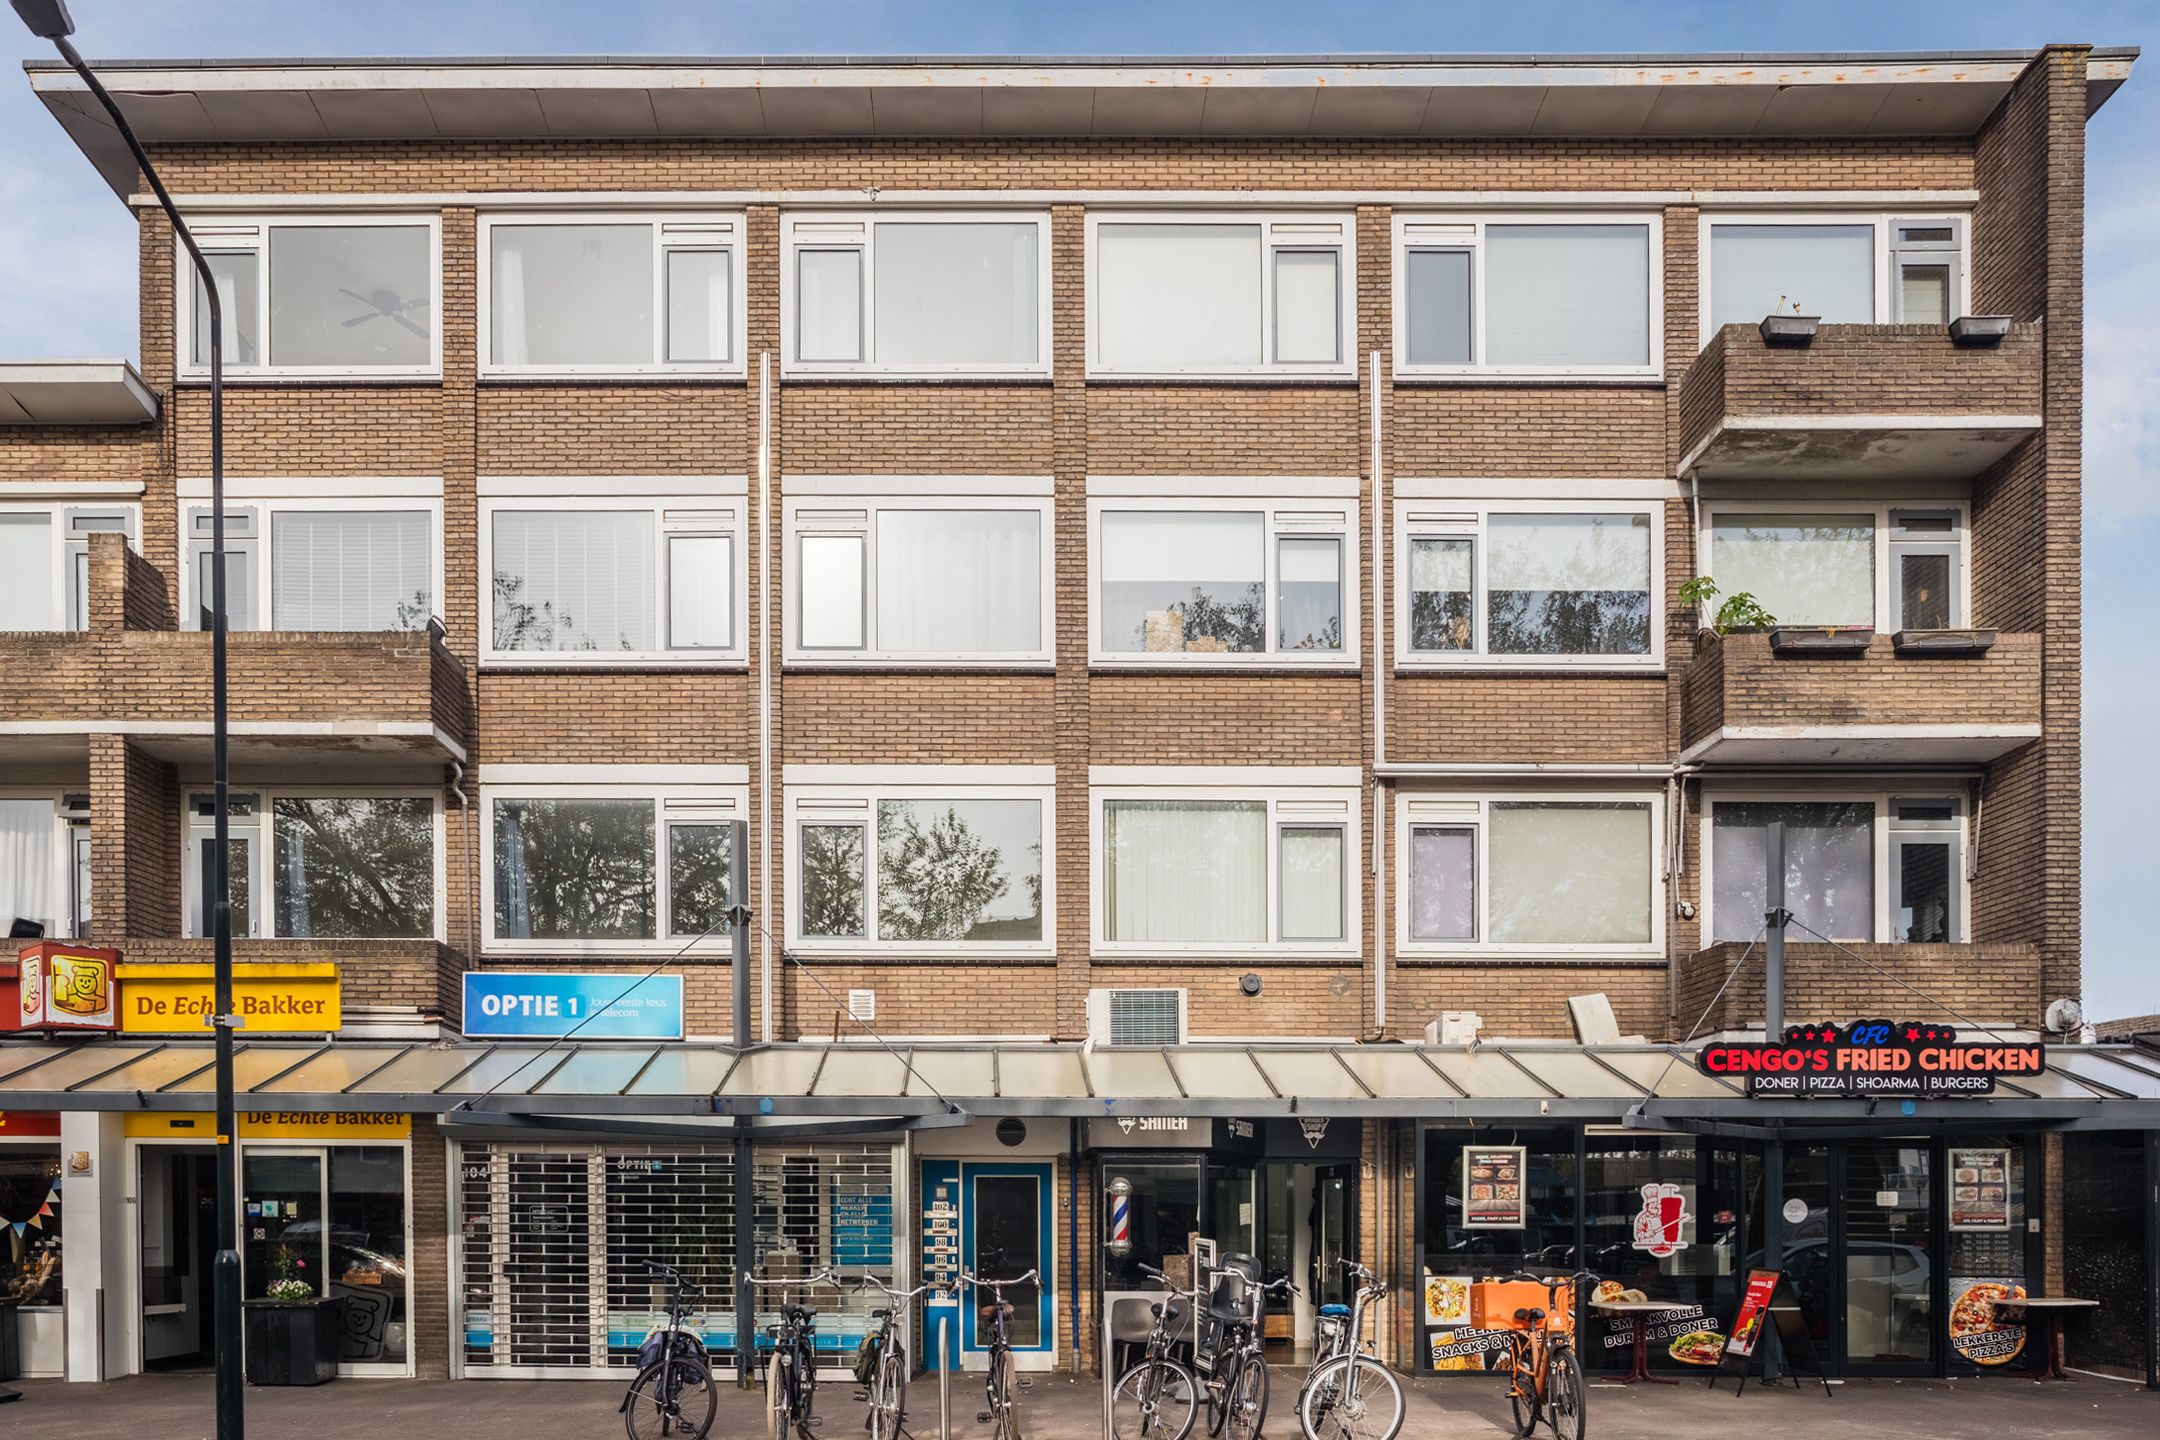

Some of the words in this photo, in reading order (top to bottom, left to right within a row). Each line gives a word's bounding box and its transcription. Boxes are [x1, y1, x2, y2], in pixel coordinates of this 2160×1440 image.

[136, 996, 166, 1015] De
[173, 996, 236, 1015] Ech
[241, 995, 326, 1014] Bakker
[481, 994, 559, 1016] OPTIE
[567, 998, 578, 1016] 1
[1850, 1025, 1889, 1045] CFC
[1706, 1049, 1829, 1072] CENGO'S
[1836, 1048, 1911, 1071] FRIED
[1918, 1048, 2039, 1071] CHICKEN
[1755, 1076, 1799, 1089] DONER
[1810, 1076, 1845, 1089] PIZZA
[1856, 1076, 1920, 1089] SHOARMA
[1931, 1076, 1988, 1089] BURGERS
[247, 1112, 272, 1124] De
[277, 1112, 329, 1125] Echte
[335, 1112, 405, 1125] Bakker
[934, 1203, 948, 1211] 102
[934, 1221, 948, 1229] 100
[936, 1238, 946, 1246] 98
[936, 1256, 946, 1264] 96
[936, 1291, 946, 1299] 92
[1610, 1304, 1703, 1331] SMKVOLLE
[1604, 1328, 1655, 1348] DURM
[1657, 1325, 1668, 1338] &
[1669, 1317, 1719, 1337] DONER
[1953, 1328, 2022, 1348] LEKKERSTE
[1432, 1336, 1489, 1359] SNACKS
[1490, 1334, 1502, 1349] &
[1969, 1342, 2015, 1359] PIZZA'S
